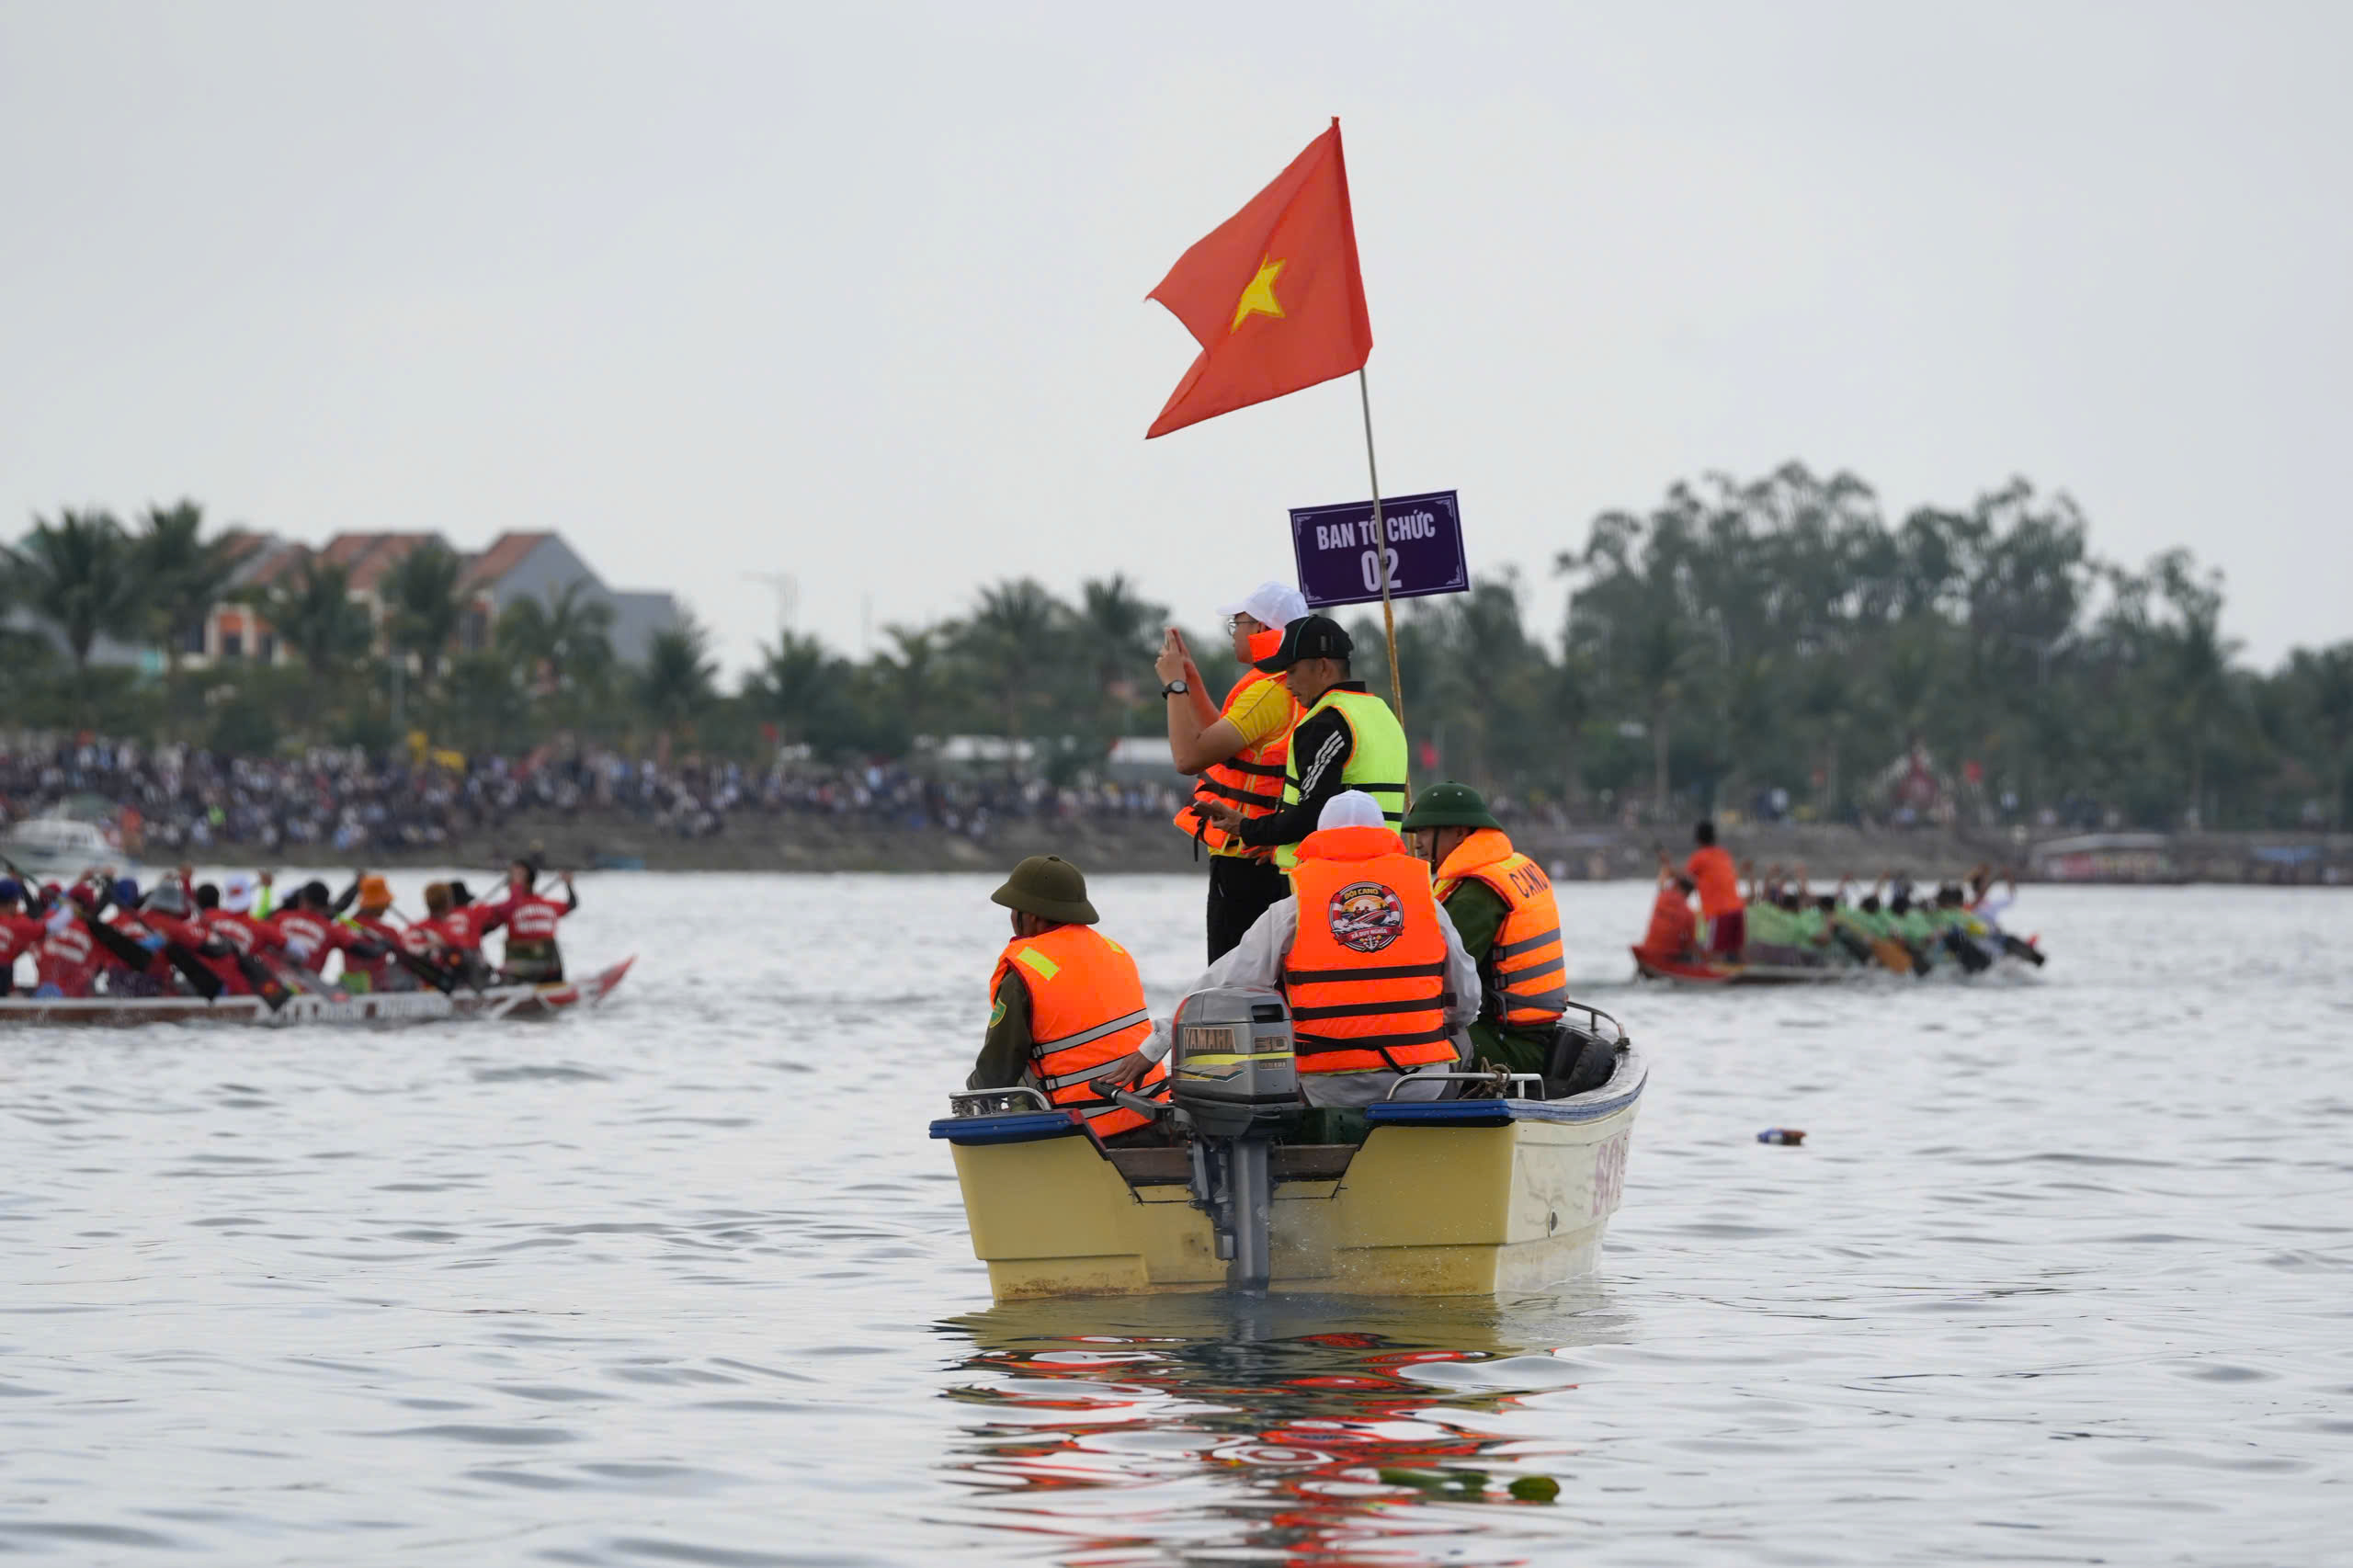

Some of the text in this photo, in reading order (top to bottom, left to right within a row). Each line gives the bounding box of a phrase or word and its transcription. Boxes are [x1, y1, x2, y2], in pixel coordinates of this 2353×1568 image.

[1316, 523, 1356, 551] BAN
[1386, 509, 1435, 541] CHỨC
[1360, 548, 1403, 592] 02
[1184, 1028, 1236, 1050] YAMAHA
